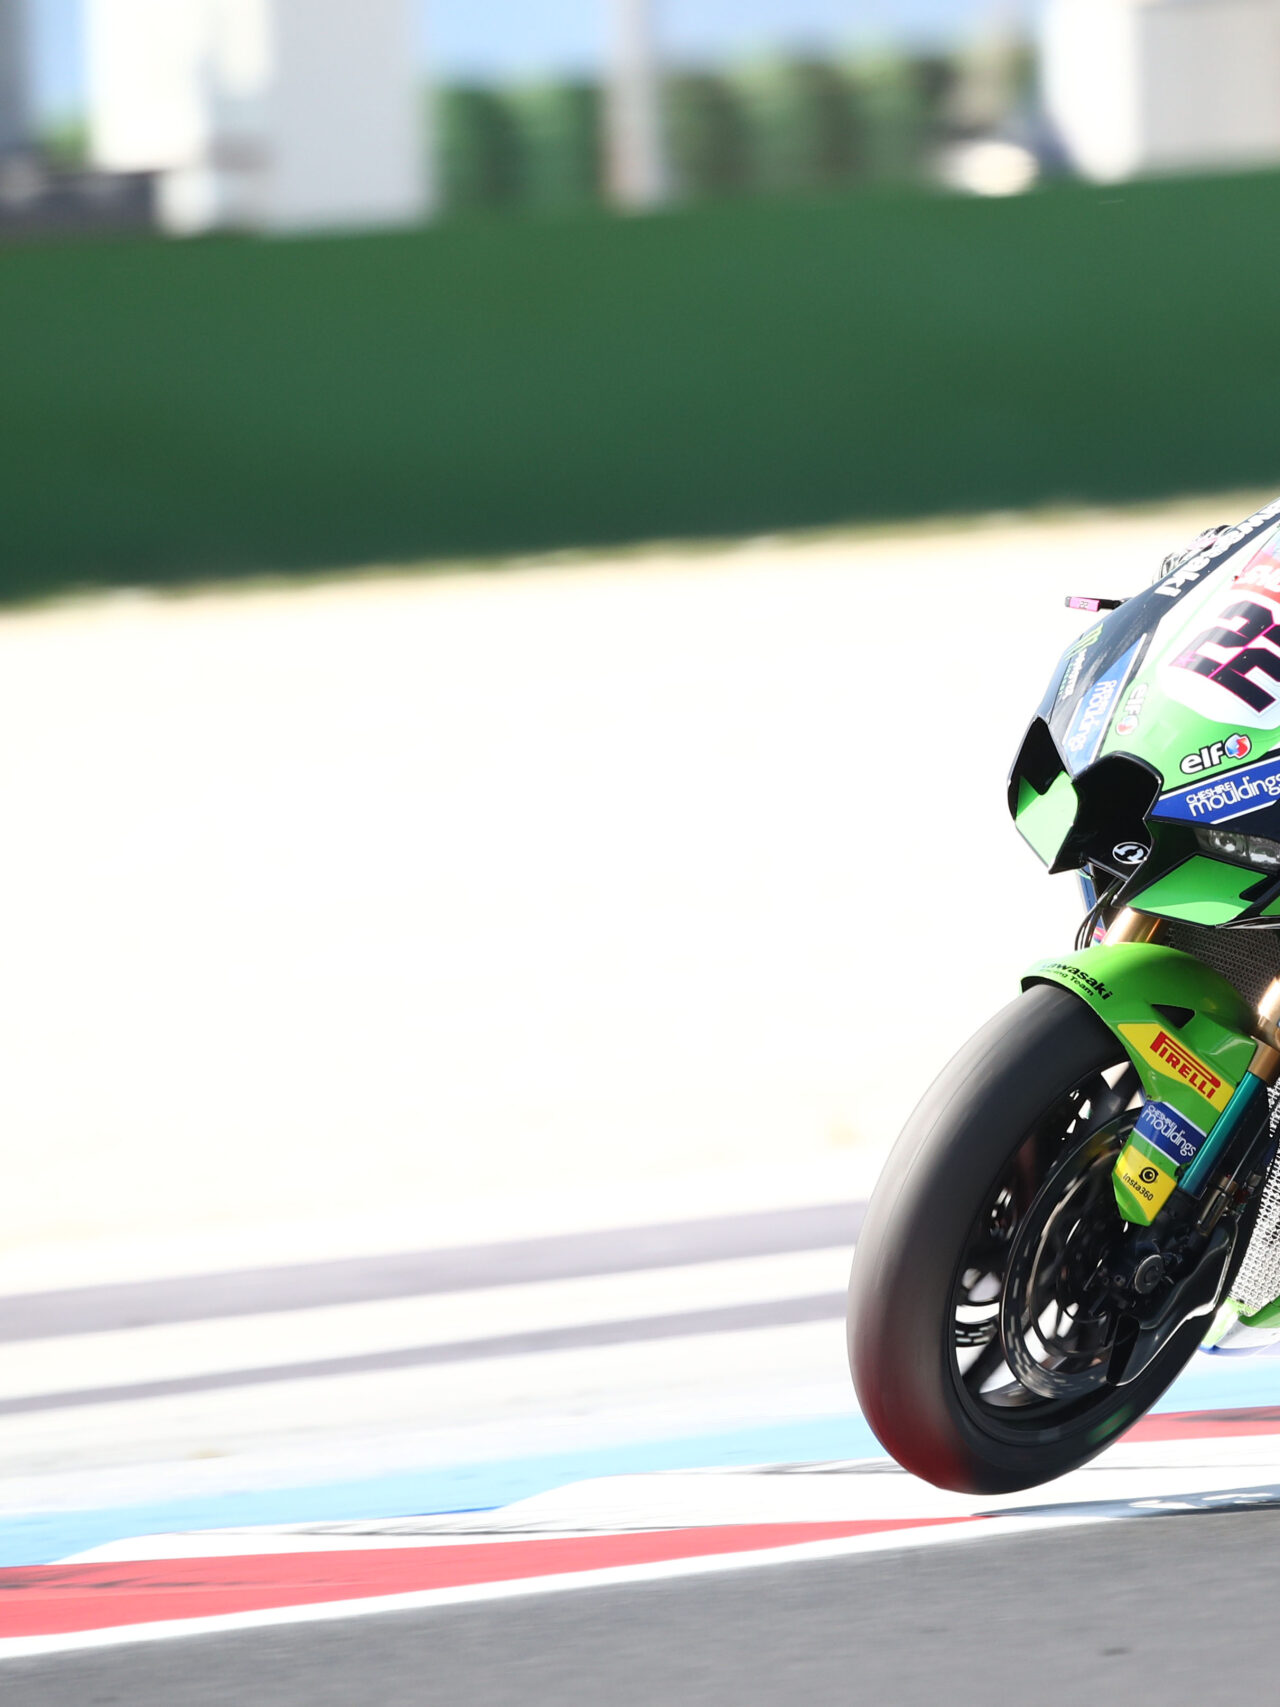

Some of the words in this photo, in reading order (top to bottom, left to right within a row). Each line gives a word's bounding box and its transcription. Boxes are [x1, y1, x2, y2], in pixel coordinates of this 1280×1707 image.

[1180, 741, 1224, 774] elf
[1186, 781, 1233, 804] CHESHIRE
[1069, 974, 1096, 998] Team
[1150, 1031, 1221, 1099] PIRELLI
[1142, 1109, 1196, 1157] mouldings
[1123, 1173, 1154, 1201] Insta360
